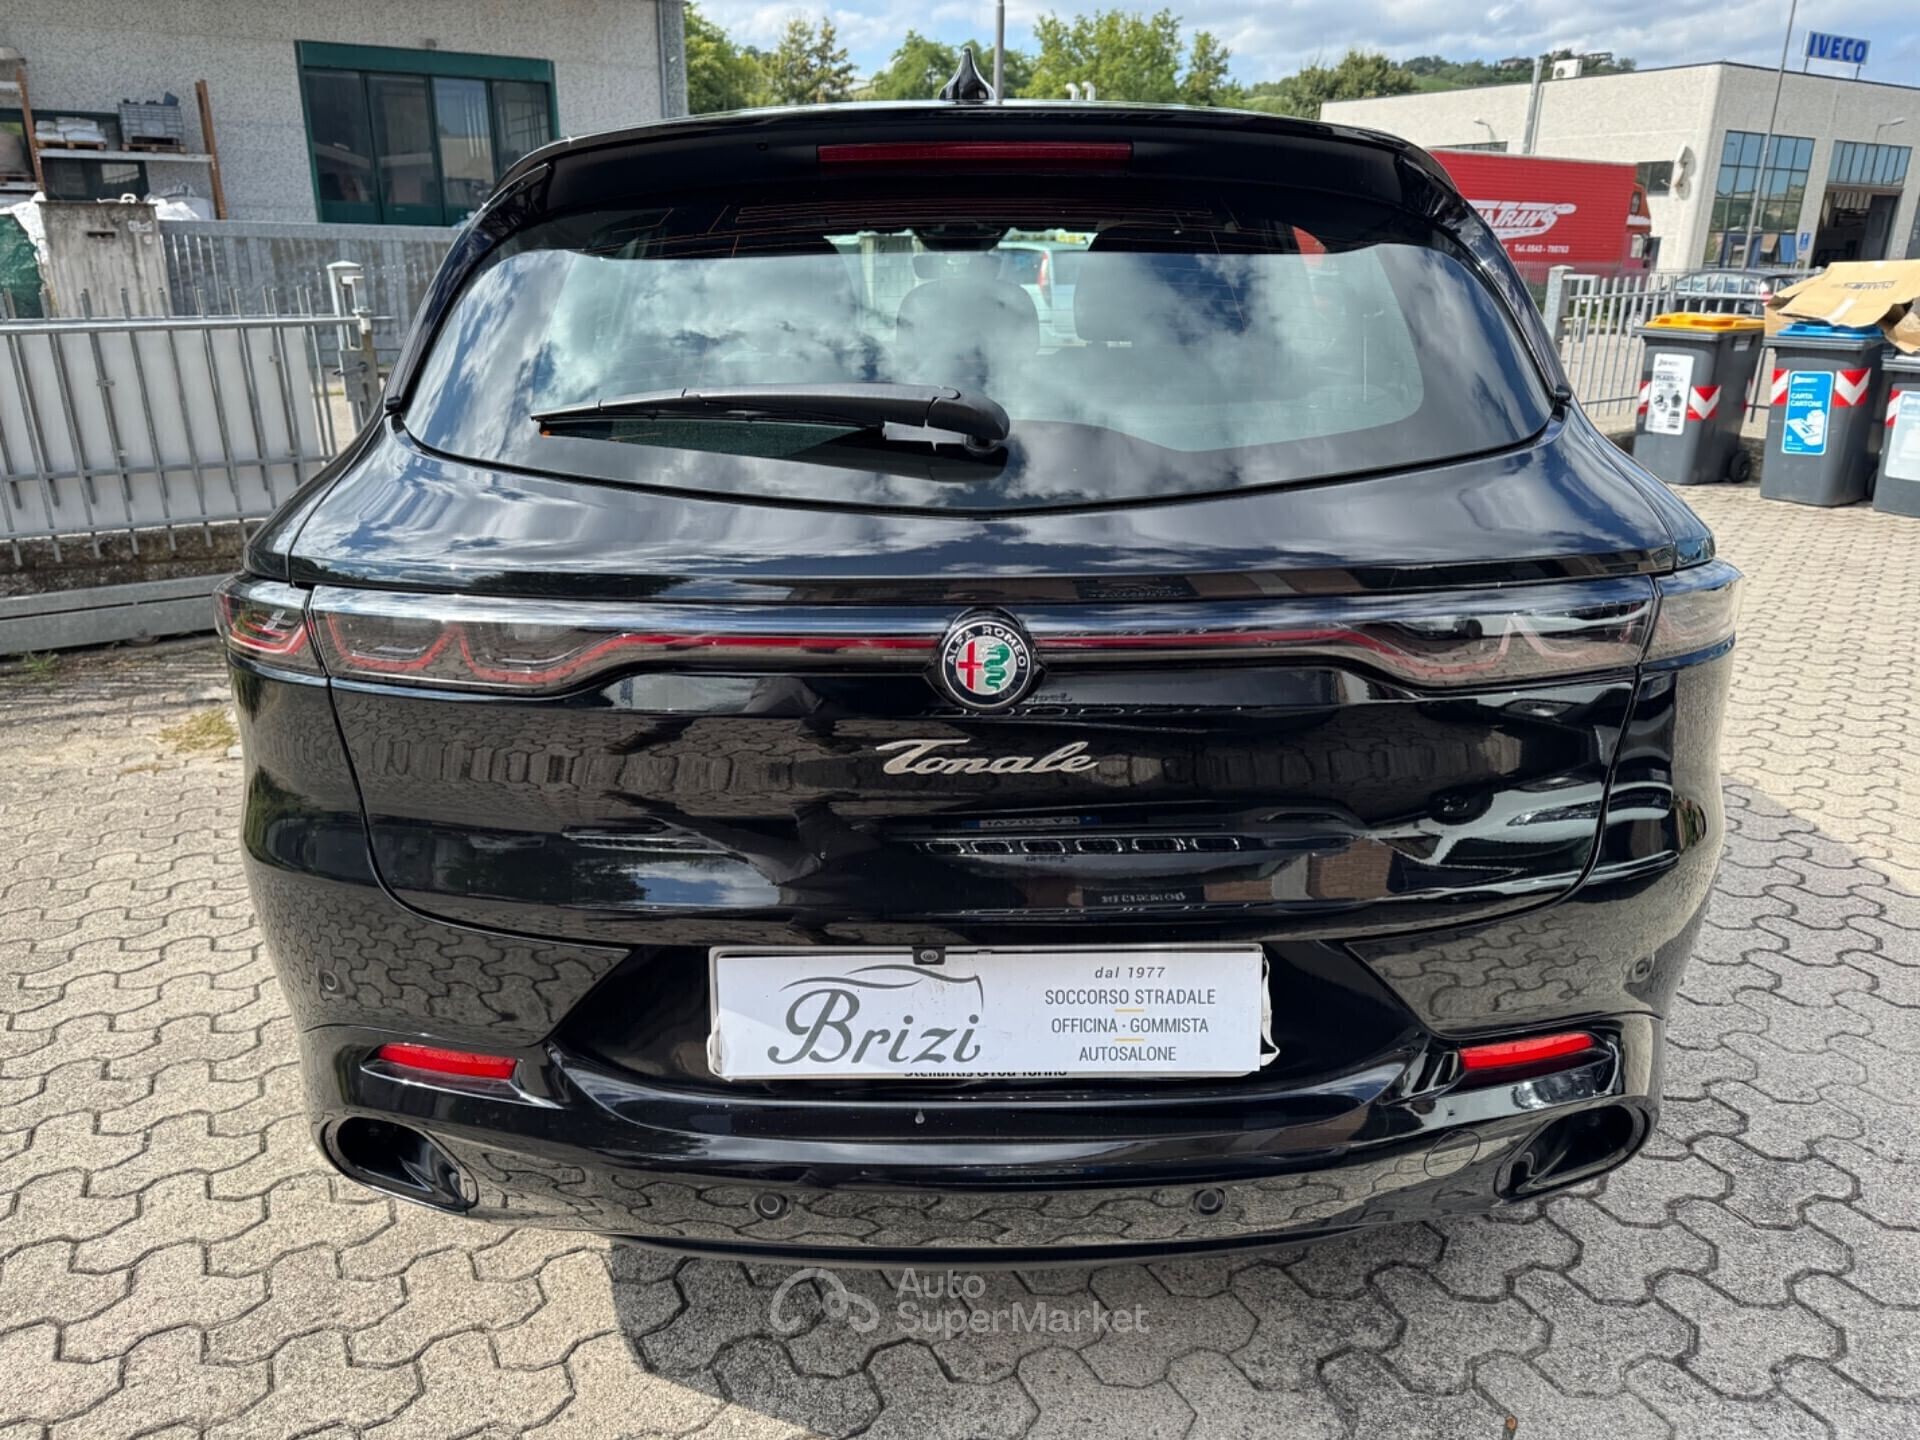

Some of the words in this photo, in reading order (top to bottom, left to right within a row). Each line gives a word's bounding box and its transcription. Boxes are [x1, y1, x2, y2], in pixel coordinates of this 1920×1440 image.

[1808, 33, 1867, 63] IVECO
[1790, 400, 1823, 408] CARTONE
[1791, 392, 1813, 400] CARTA
[946, 629, 977, 667] ALFA
[981, 624, 1028, 668] ROMEO
[875, 738, 1099, 775] Tonale
[1094, 966, 1120, 979] dal
[1126, 966, 1166, 979] 1977
[1044, 988, 1130, 1005] SOCCORSO
[1134, 988, 1217, 1005] STRADALE
[767, 988, 982, 1065] Brizi
[1051, 1017, 1119, 1034] OFFICINA
[1129, 1017, 1210, 1034] GOMMISTA
[1078, 1046, 1177, 1062] AUTOSALONE
